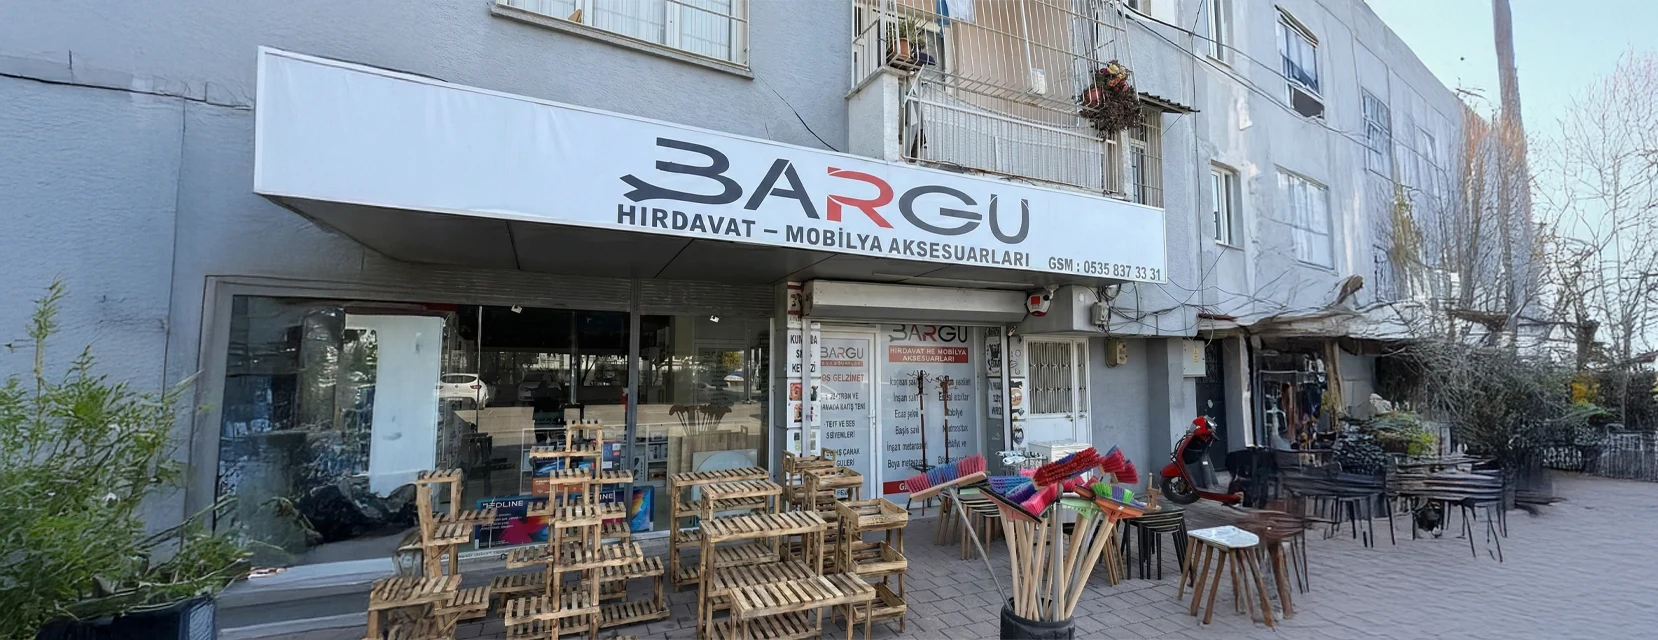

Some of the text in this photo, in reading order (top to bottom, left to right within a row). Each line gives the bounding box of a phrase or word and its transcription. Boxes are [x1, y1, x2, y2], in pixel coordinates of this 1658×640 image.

[620, 137, 1030, 244] BARGU
[617, 203, 755, 238] HIRDAVAT
[785, 225, 883, 253] MOBİLYA
[888, 238, 1030, 268] AKSESUARLARI
[1048, 256, 1073, 272] GSM
[1083, 260, 1110, 276] 0535
[1113, 263, 1132, 278] 837
[1135, 266, 1147, 280] 33
[1149, 267, 1161, 281] 31
[888, 324, 968, 343] BARGU
[821, 346, 864, 359] BARGU
